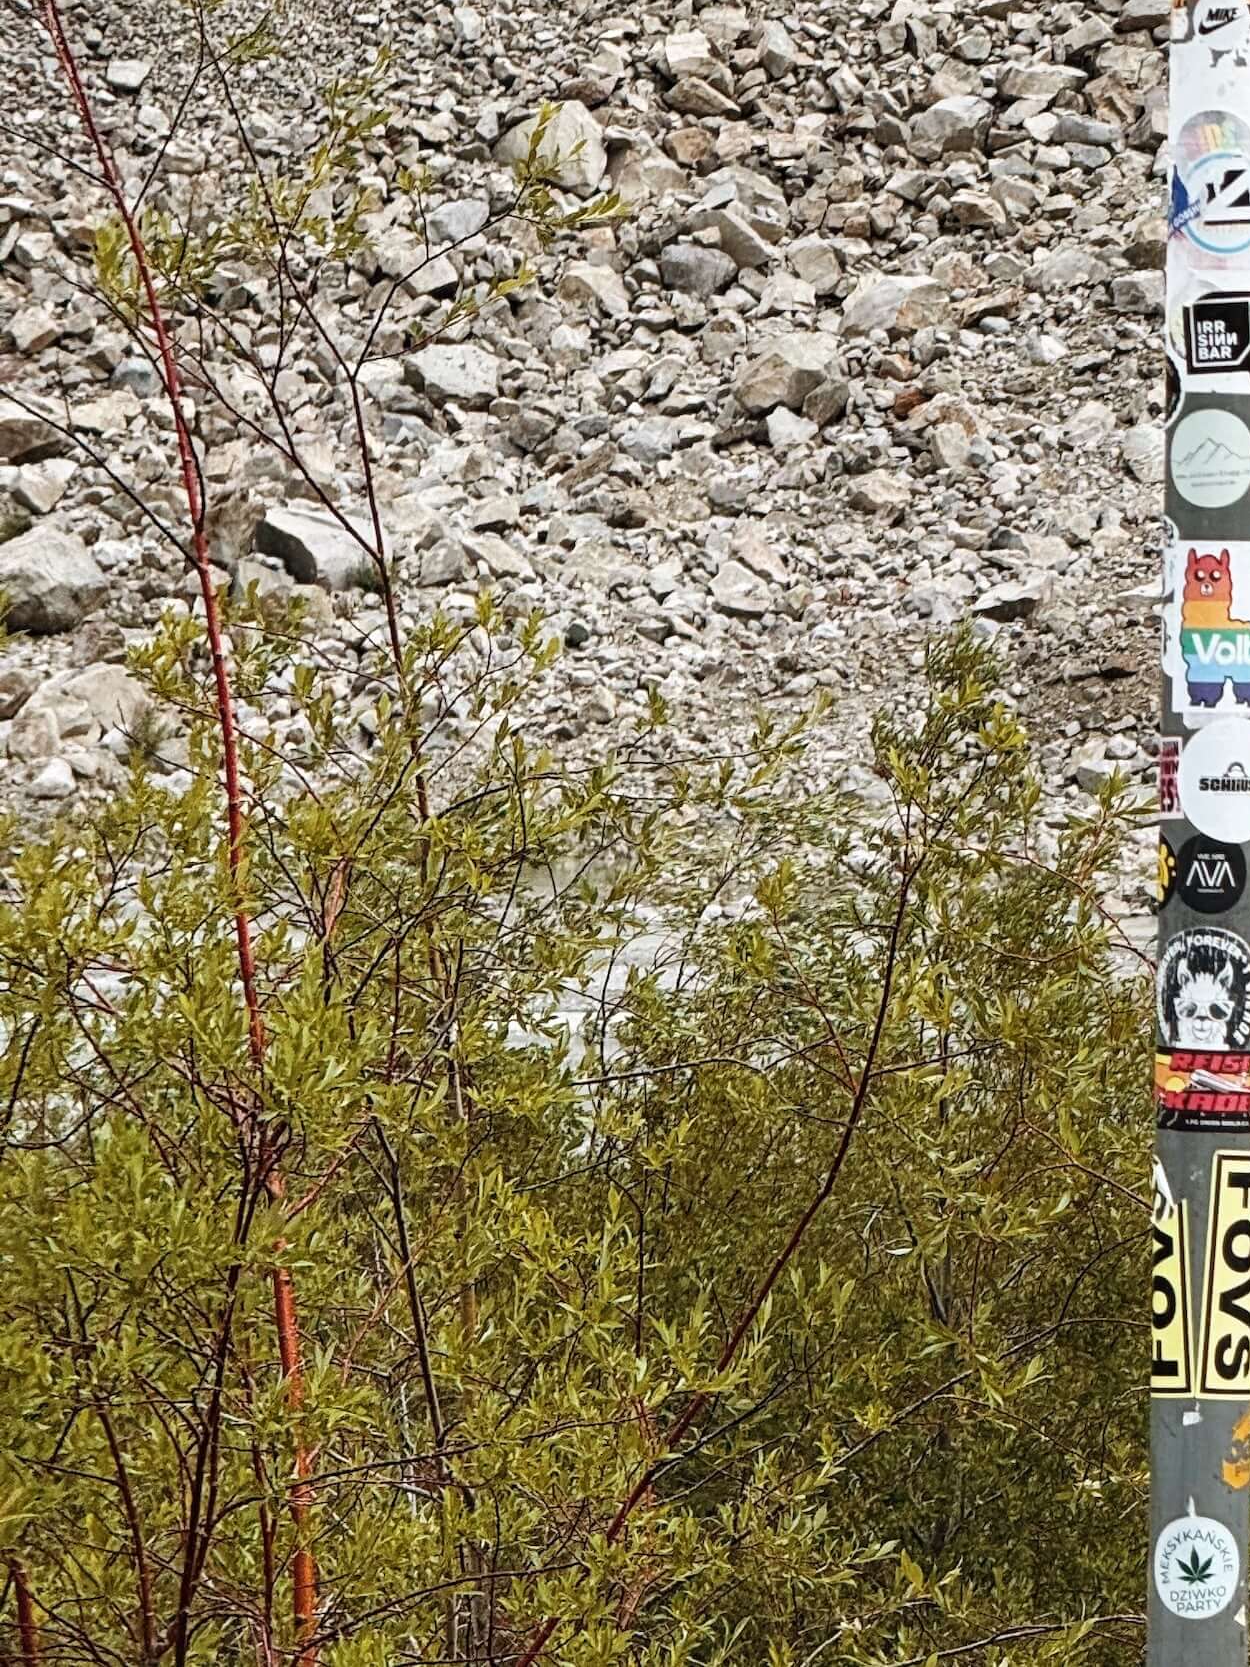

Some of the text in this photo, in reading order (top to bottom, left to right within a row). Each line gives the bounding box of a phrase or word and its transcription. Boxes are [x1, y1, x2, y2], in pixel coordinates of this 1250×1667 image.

[1197, 319, 1226, 335] IRR
[1198, 346, 1233, 360] BAR
[1186, 860, 1236, 888] AVA
[1169, 1585, 1226, 1602] DZIWKO
[1176, 1599, 1222, 1613] PARTY
